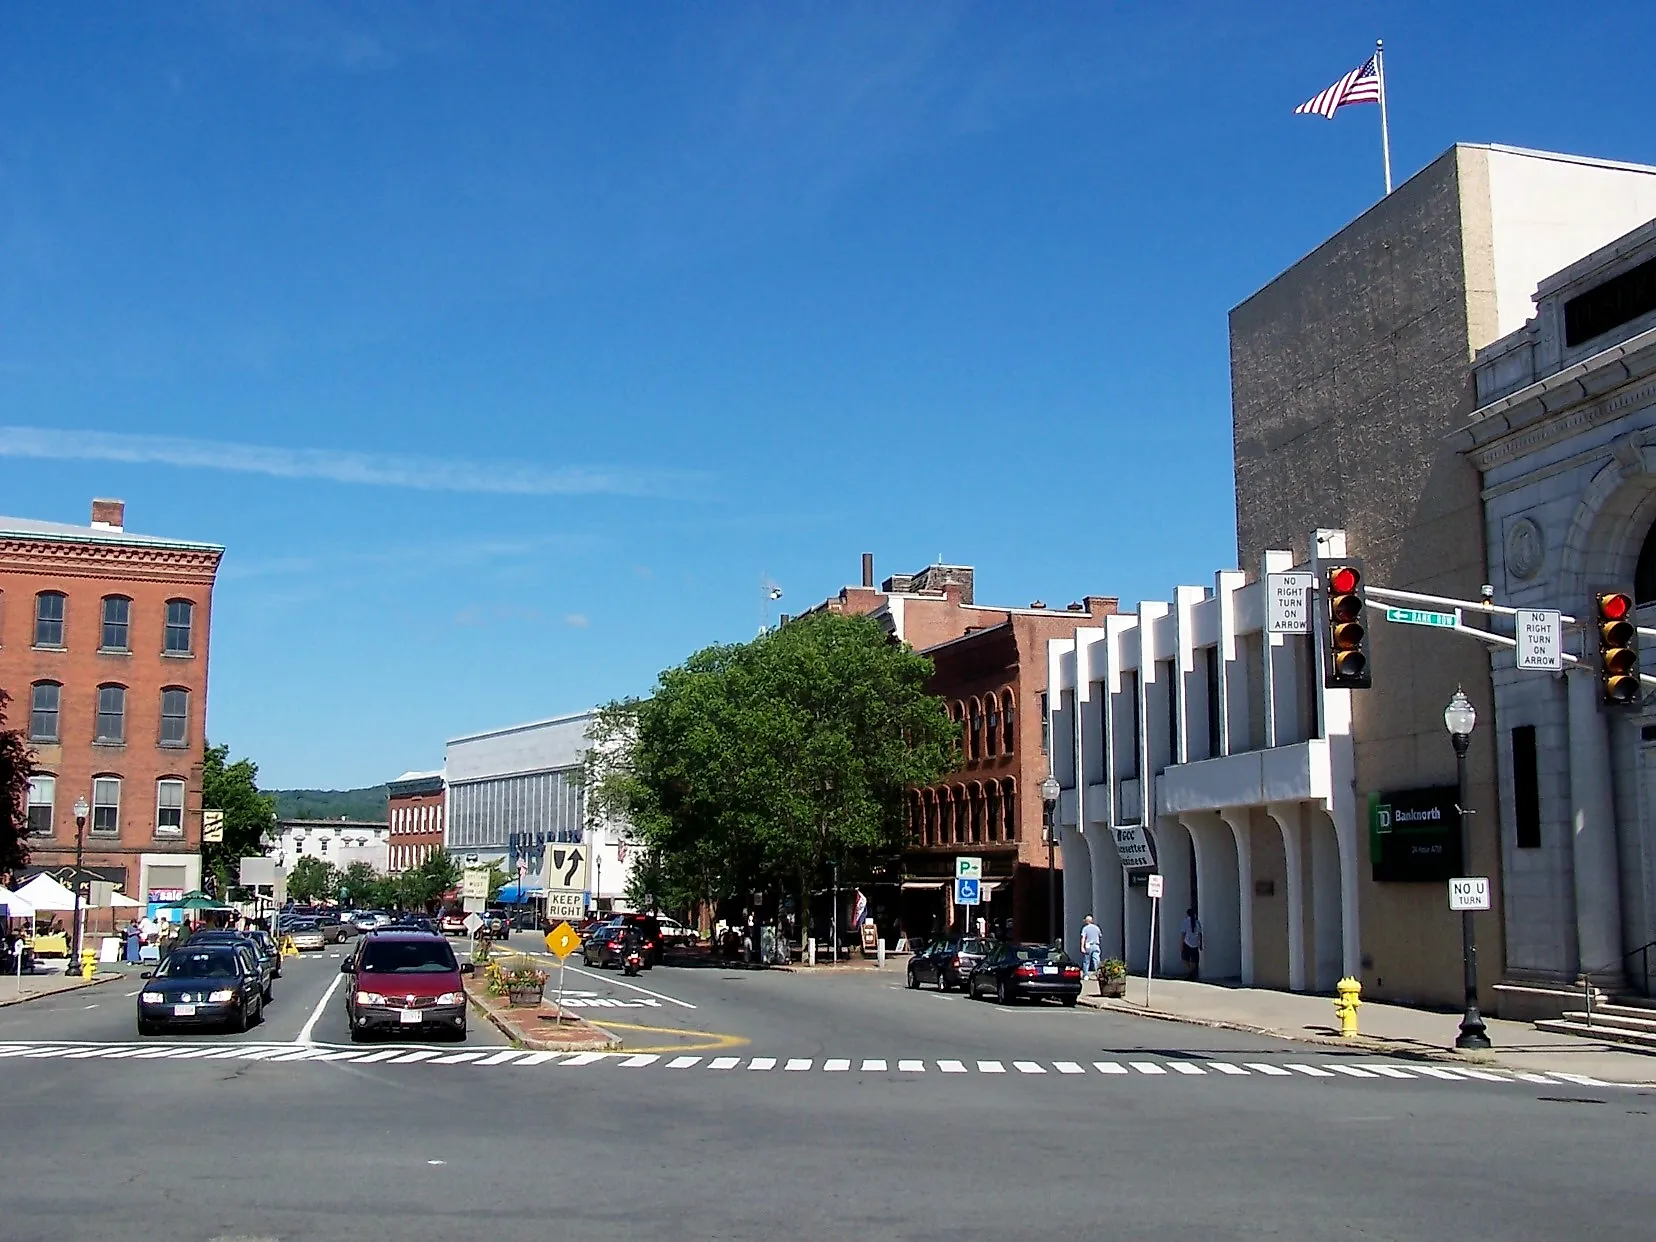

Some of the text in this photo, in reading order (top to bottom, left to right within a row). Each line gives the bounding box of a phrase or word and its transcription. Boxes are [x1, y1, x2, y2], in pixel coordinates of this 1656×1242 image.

[1284, 577, 1296, 585] NO
[1277, 588, 1303, 596] RIGHT
[1278, 599, 1302, 607] TURN
[1284, 610, 1297, 618] ON
[1532, 613, 1545, 622] NO
[1274, 621, 1306, 629] ARROW
[1526, 624, 1551, 633] RIGHT
[1528, 635, 1551, 644] TURN
[1533, 646, 1546, 654] ON
[1524, 656, 1555, 665] ARROW
[1395, 807, 1440, 821] Banknorth
[960, 861, 970, 874] P
[1454, 883, 1484, 894] NO U
[160, 890, 182, 901] sale
[552, 894, 581, 905] KEEP
[1458, 896, 1482, 904] TURN
[550, 906, 582, 916] RIGHT
[555, 998, 662, 1007] ONLY
